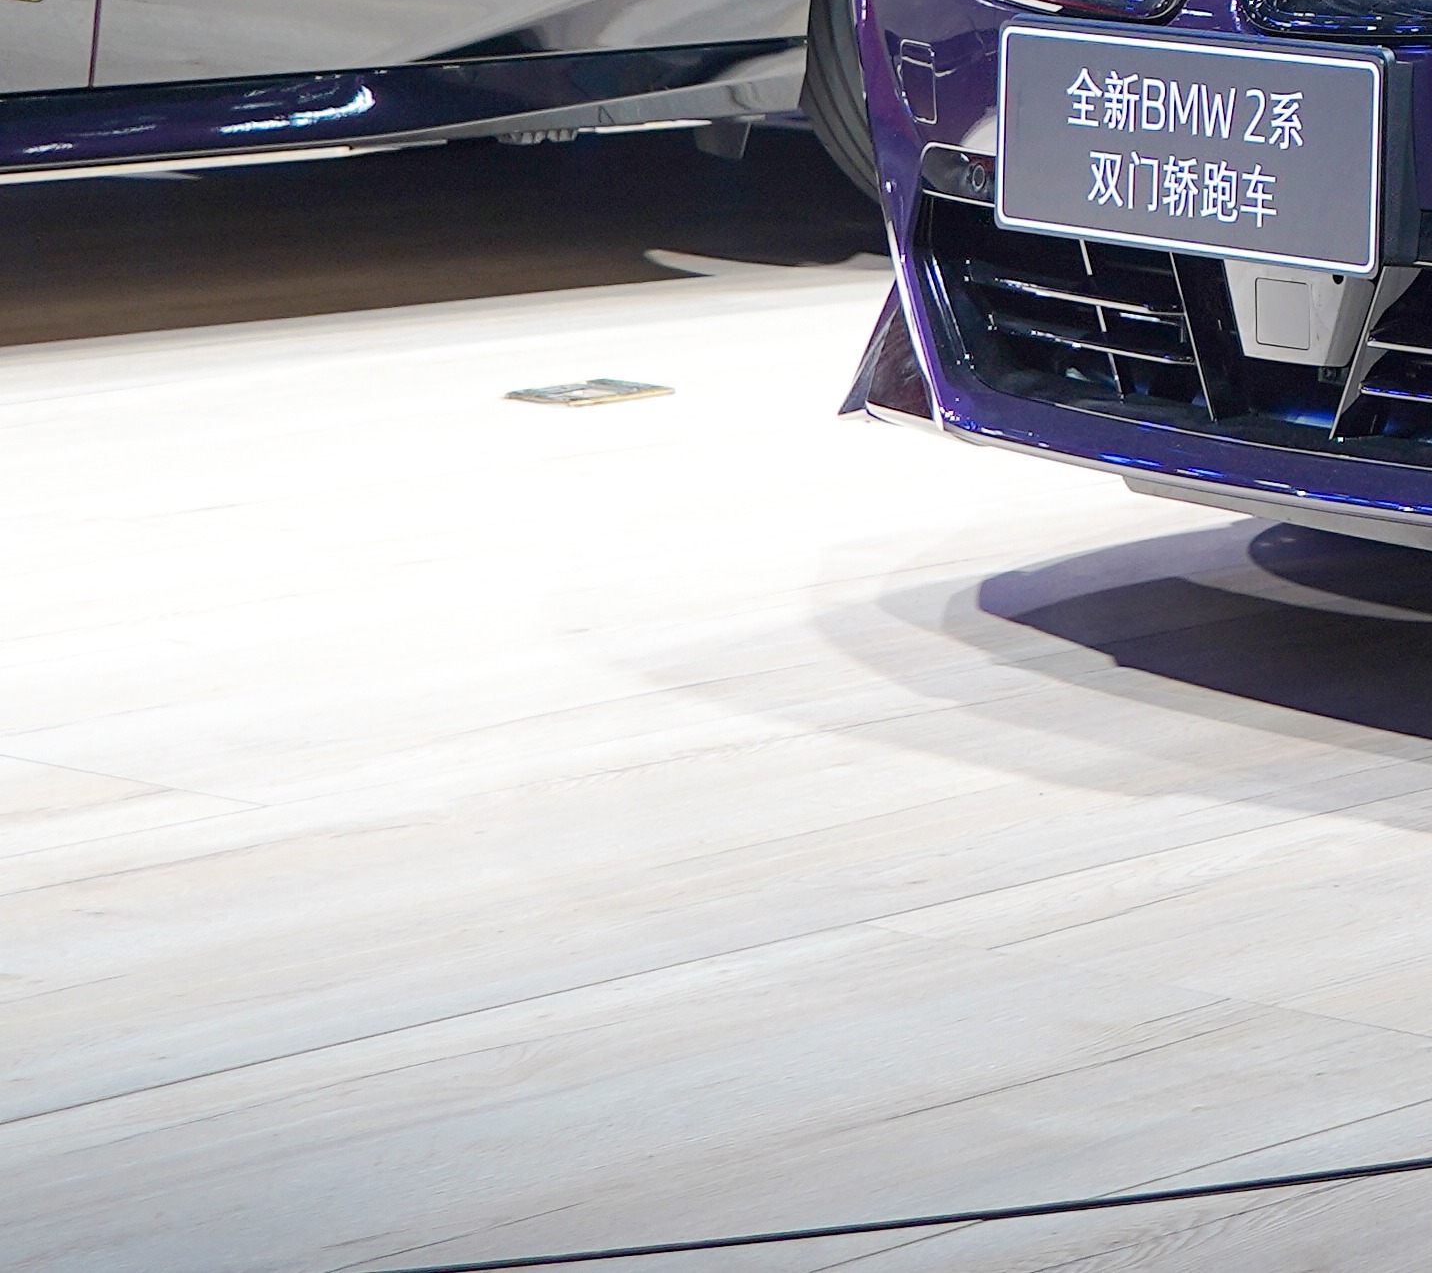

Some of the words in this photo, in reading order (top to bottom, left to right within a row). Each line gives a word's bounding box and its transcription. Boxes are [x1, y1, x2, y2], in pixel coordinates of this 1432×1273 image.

[1066, 67, 1237, 140] 全新BMW
[1244, 89, 1304, 151] 2系
[1087, 150, 1278, 228] 双门轿跑车
